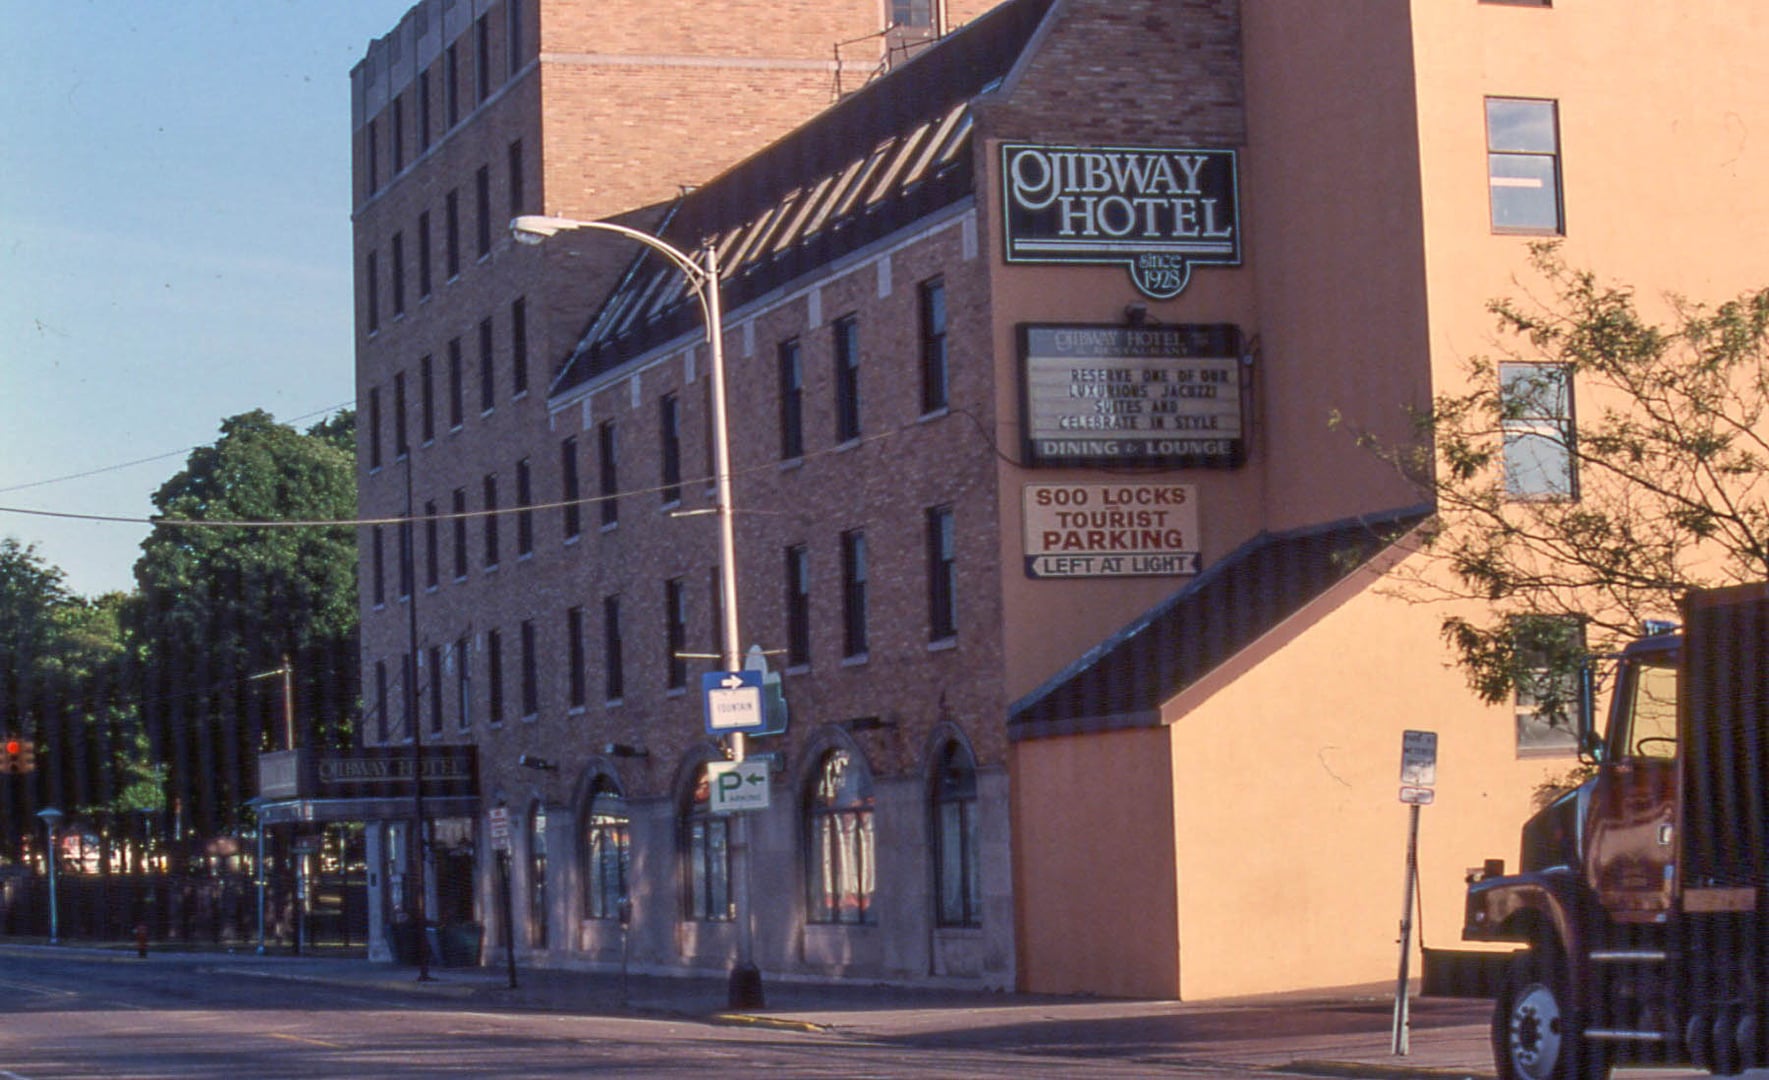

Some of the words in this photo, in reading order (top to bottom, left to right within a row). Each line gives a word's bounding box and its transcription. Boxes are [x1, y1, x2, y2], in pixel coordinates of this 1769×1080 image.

[1011, 150, 1208, 209] OJIBWAY
[1058, 196, 1232, 237] HOTEL
[1144, 270, 1181, 289] 1928
[1127, 331, 1182, 346] HOTEL
[1071, 368, 1132, 383] RESERVE
[1142, 368, 1168, 383] ONE
[1178, 368, 1195, 383] OF
[1201, 368, 1229, 383] OUR
[1095, 400, 1143, 414] SUITES
[1152, 401, 1178, 413] AND
[1059, 416, 1138, 430] CELEBRATE
[1150, 416, 1164, 430] IN
[1175, 416, 1218, 430] STYLE
[1043, 441, 1119, 456] DINING
[1147, 441, 1232, 456] LOUNGE
[1036, 488, 1088, 506] SOO
[1103, 487, 1186, 505] LOCKS
[1056, 510, 1169, 529] TOURIST
[1043, 529, 1183, 551] PARKING
[1043, 557, 1095, 574] LEFT
[1101, 557, 1124, 573] AT
[1132, 556, 1188, 572] LIGHT
